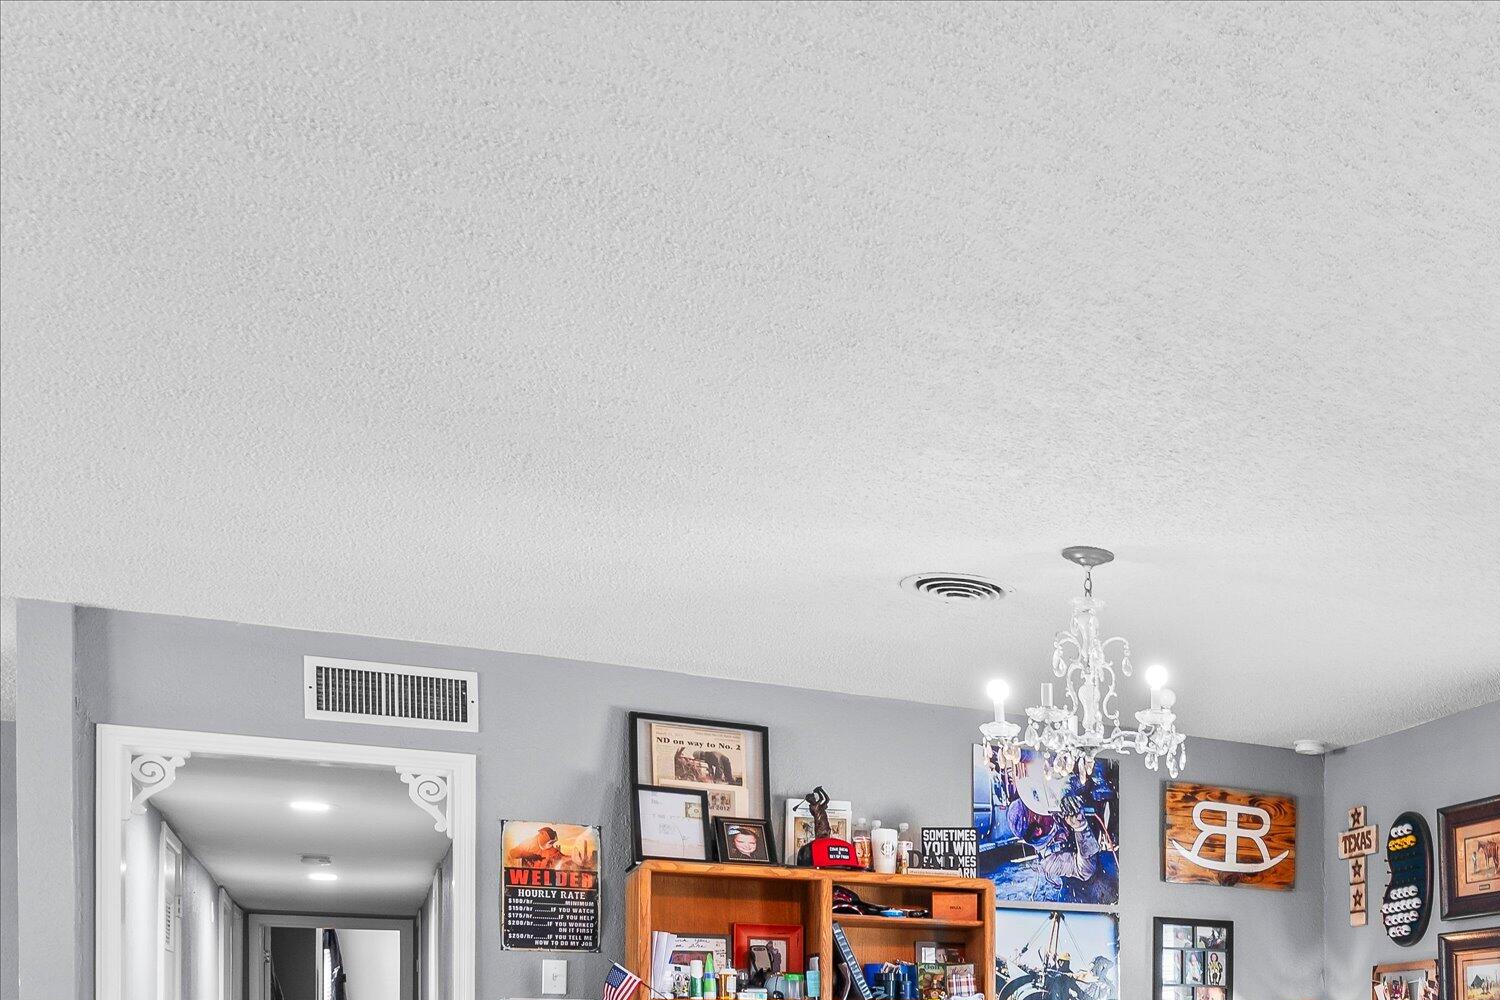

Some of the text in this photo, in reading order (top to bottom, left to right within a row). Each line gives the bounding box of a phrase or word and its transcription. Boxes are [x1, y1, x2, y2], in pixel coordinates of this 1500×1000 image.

[656, 736, 670, 744] ND
[687, 740, 704, 748] way
[706, 740, 716, 748] to
[718, 742, 733, 750] No.
[922, 830, 976, 841] SOMETIMES
[1342, 830, 1372, 854] TEXAS
[924, 841, 976, 856] YOU WIN
[510, 869, 593, 888] WELDER
[518, 889, 586, 900] HOURLY RATE
